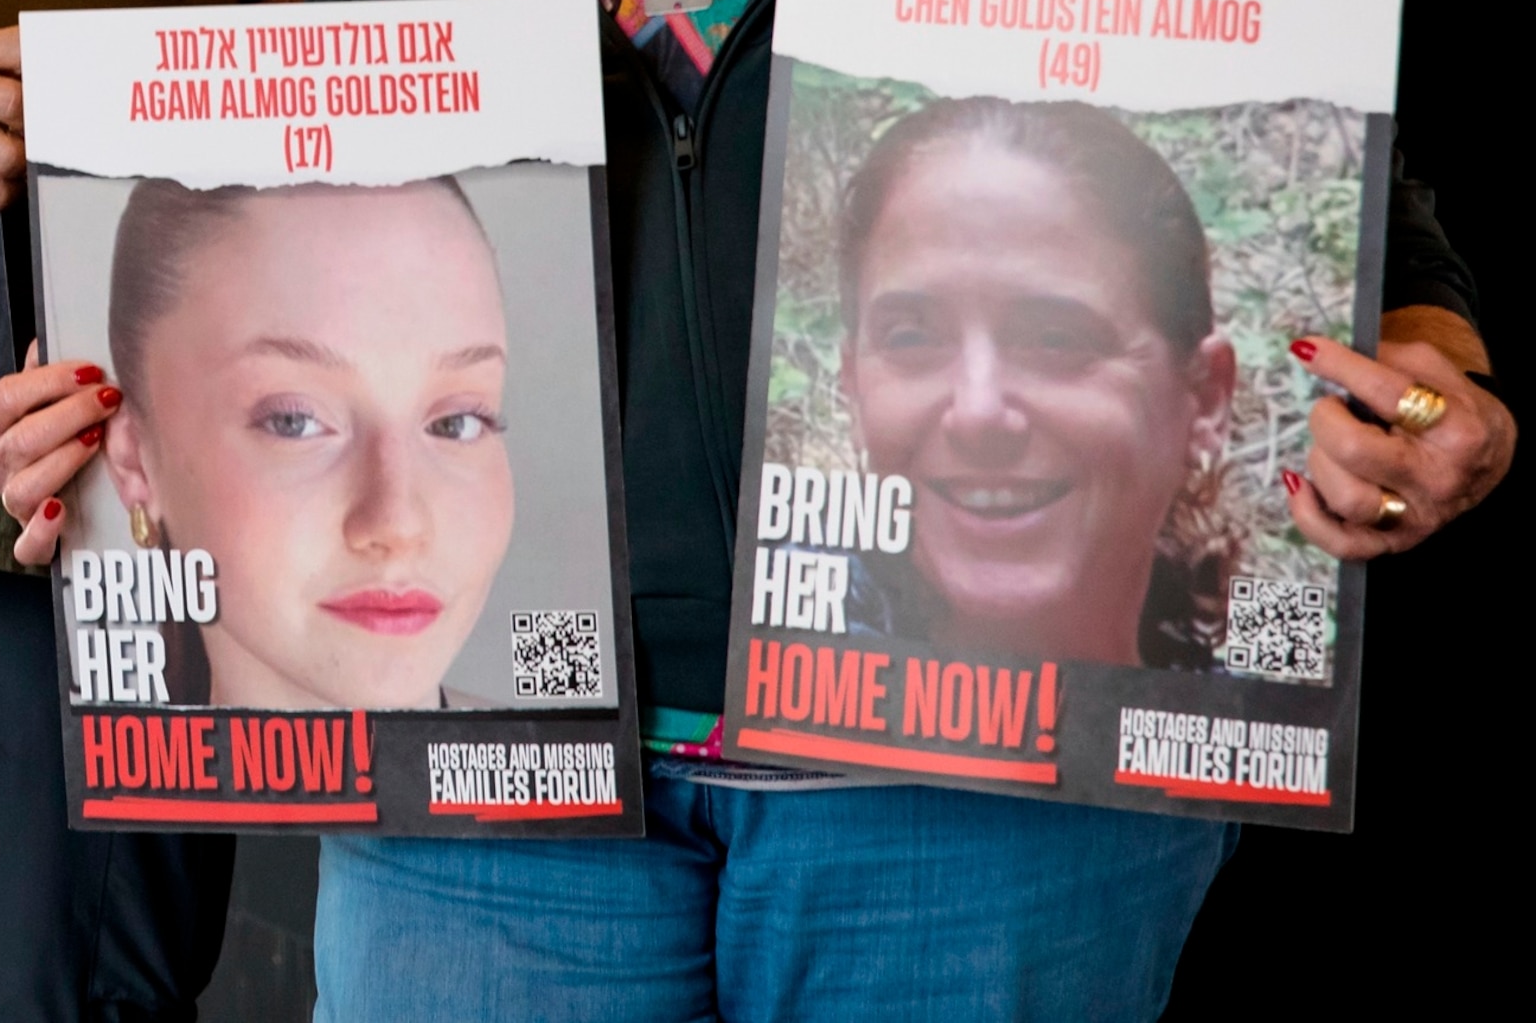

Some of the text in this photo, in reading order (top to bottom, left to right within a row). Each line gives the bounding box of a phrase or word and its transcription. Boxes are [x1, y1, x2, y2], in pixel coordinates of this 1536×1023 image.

[154, 22, 456, 73] אגם גולדשטיין אלמוג
[1038, 38, 1101, 91] (49)
[129, 71, 481, 122] AGAM ALMOG GOLDSTEIN
[283, 125, 333, 172] (17)
[757, 462, 913, 555] BRING
[71, 548, 217, 623] BRING
[751, 547, 849, 634] HER
[76, 629, 170, 703] HER
[745, 638, 1059, 752] HOME NOW!
[82, 709, 375, 794] HOME NOW!
[428, 742, 614, 770] HOSTAGES AND MISSING
[1120, 707, 1328, 756] HOSTAGES AND MISSING
[430, 769, 616, 805] FAMILIES FORUM
[1118, 736, 1328, 795] FAMILIES FORUM
